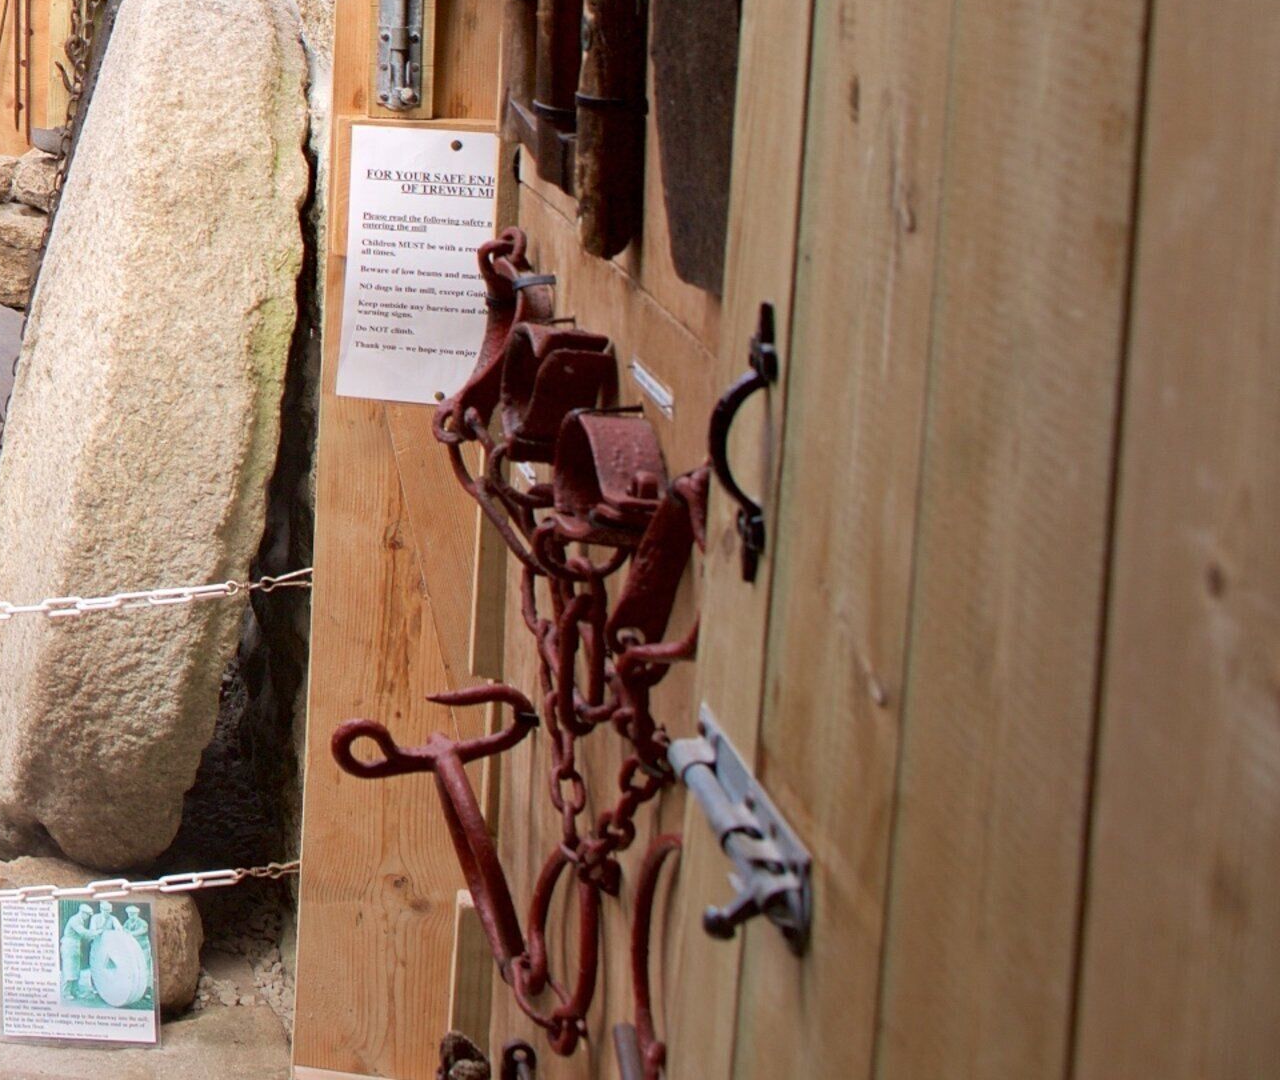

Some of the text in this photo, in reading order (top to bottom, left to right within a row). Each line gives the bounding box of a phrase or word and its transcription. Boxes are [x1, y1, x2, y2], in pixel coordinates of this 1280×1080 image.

[367, 169, 392, 180] FOR
[395, 171, 430, 181] YOUR
[434, 173, 466, 184] SAFE
[401, 183, 418, 193] OF
[422, 185, 474, 196] TREWEY
[362, 222, 394, 231] entering
[363, 212, 387, 221] Please
[389, 214, 407, 222] read
[409, 215, 422, 223] the
[424, 216, 459, 226] following
[462, 218, 484, 228] safety
[362, 239, 396, 247] Children
[398, 241, 425, 249] MUST
[361, 265, 388, 274] Beware
[417, 269, 442, 277] beams
[374, 284, 392, 292] dogs
[439, 289, 464, 297] except
[358, 300, 378, 308] Keep
[380, 302, 408, 310] outside
[426, 304, 458, 314] barriers
[358, 310, 389, 318] warning
[355, 341, 380, 349] Thank
[418, 346, 437, 354] hope
[440, 348, 454, 356] you
[456, 348, 477, 357] enjoy
